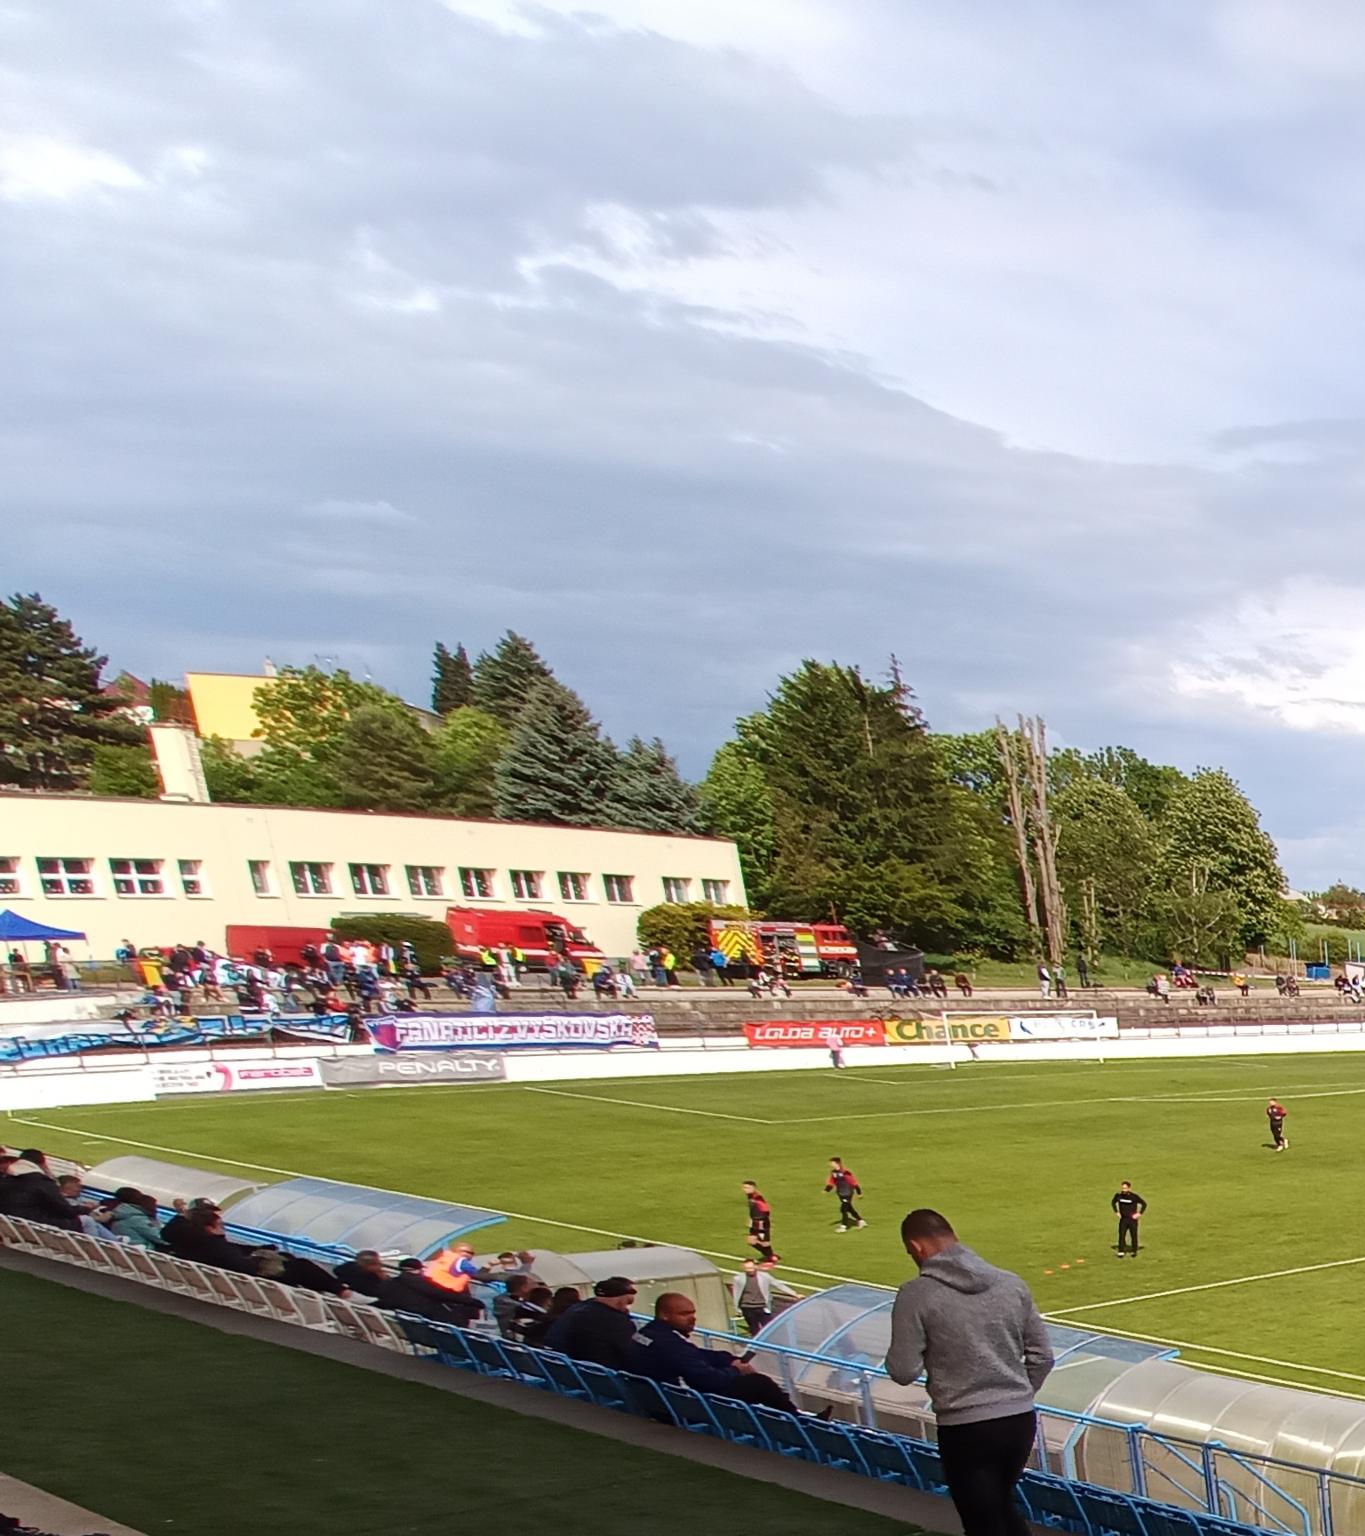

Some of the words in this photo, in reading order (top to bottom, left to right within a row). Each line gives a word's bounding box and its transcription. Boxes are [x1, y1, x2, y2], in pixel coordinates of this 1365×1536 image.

[754, 1026, 814, 1040] LOUDA
[896, 1019, 1000, 1040] Chance
[378, 1058, 498, 1077] PENALTY
